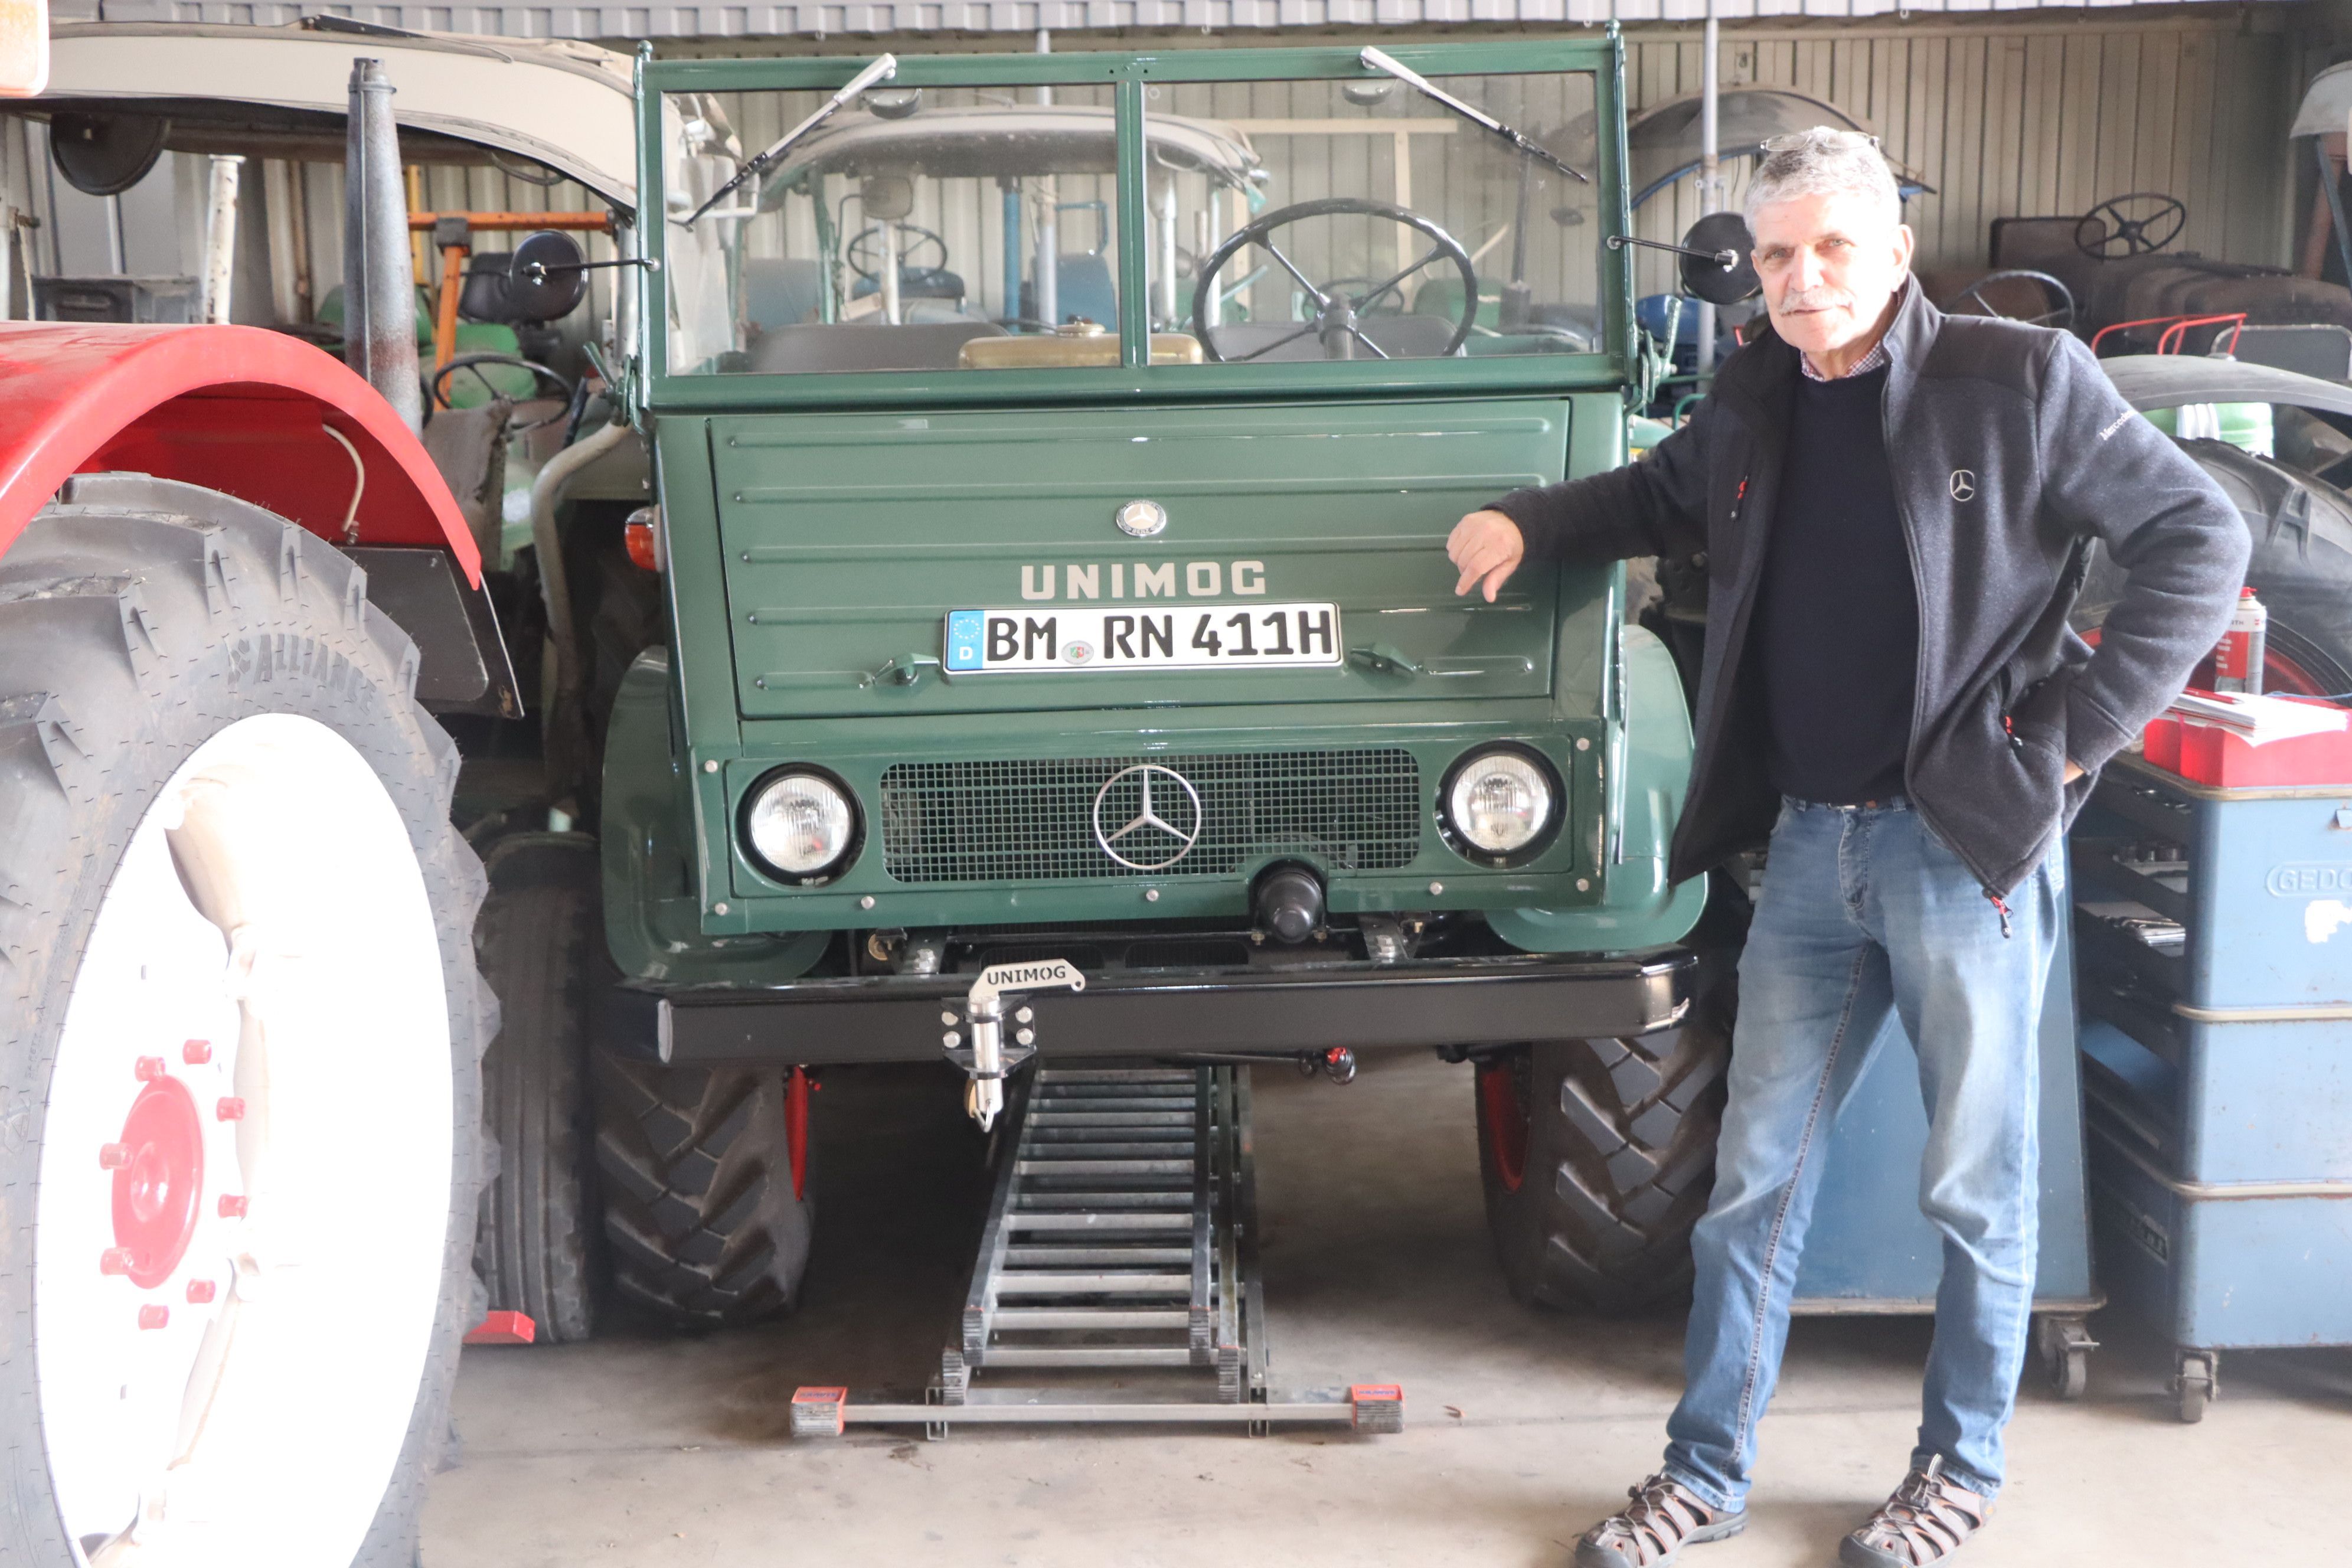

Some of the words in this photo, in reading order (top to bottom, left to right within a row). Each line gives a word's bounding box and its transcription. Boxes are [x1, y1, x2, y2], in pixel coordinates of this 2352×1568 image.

[1021, 560, 1266, 600] UNIMOG
[959, 646, 974, 661] D
[986, 616, 1057, 662] BM
[1103, 615, 1173, 659] RN
[1191, 610, 1333, 657] 411H
[253, 633, 377, 716] ALLIANCE
[987, 965, 1066, 985] UNIMOG
